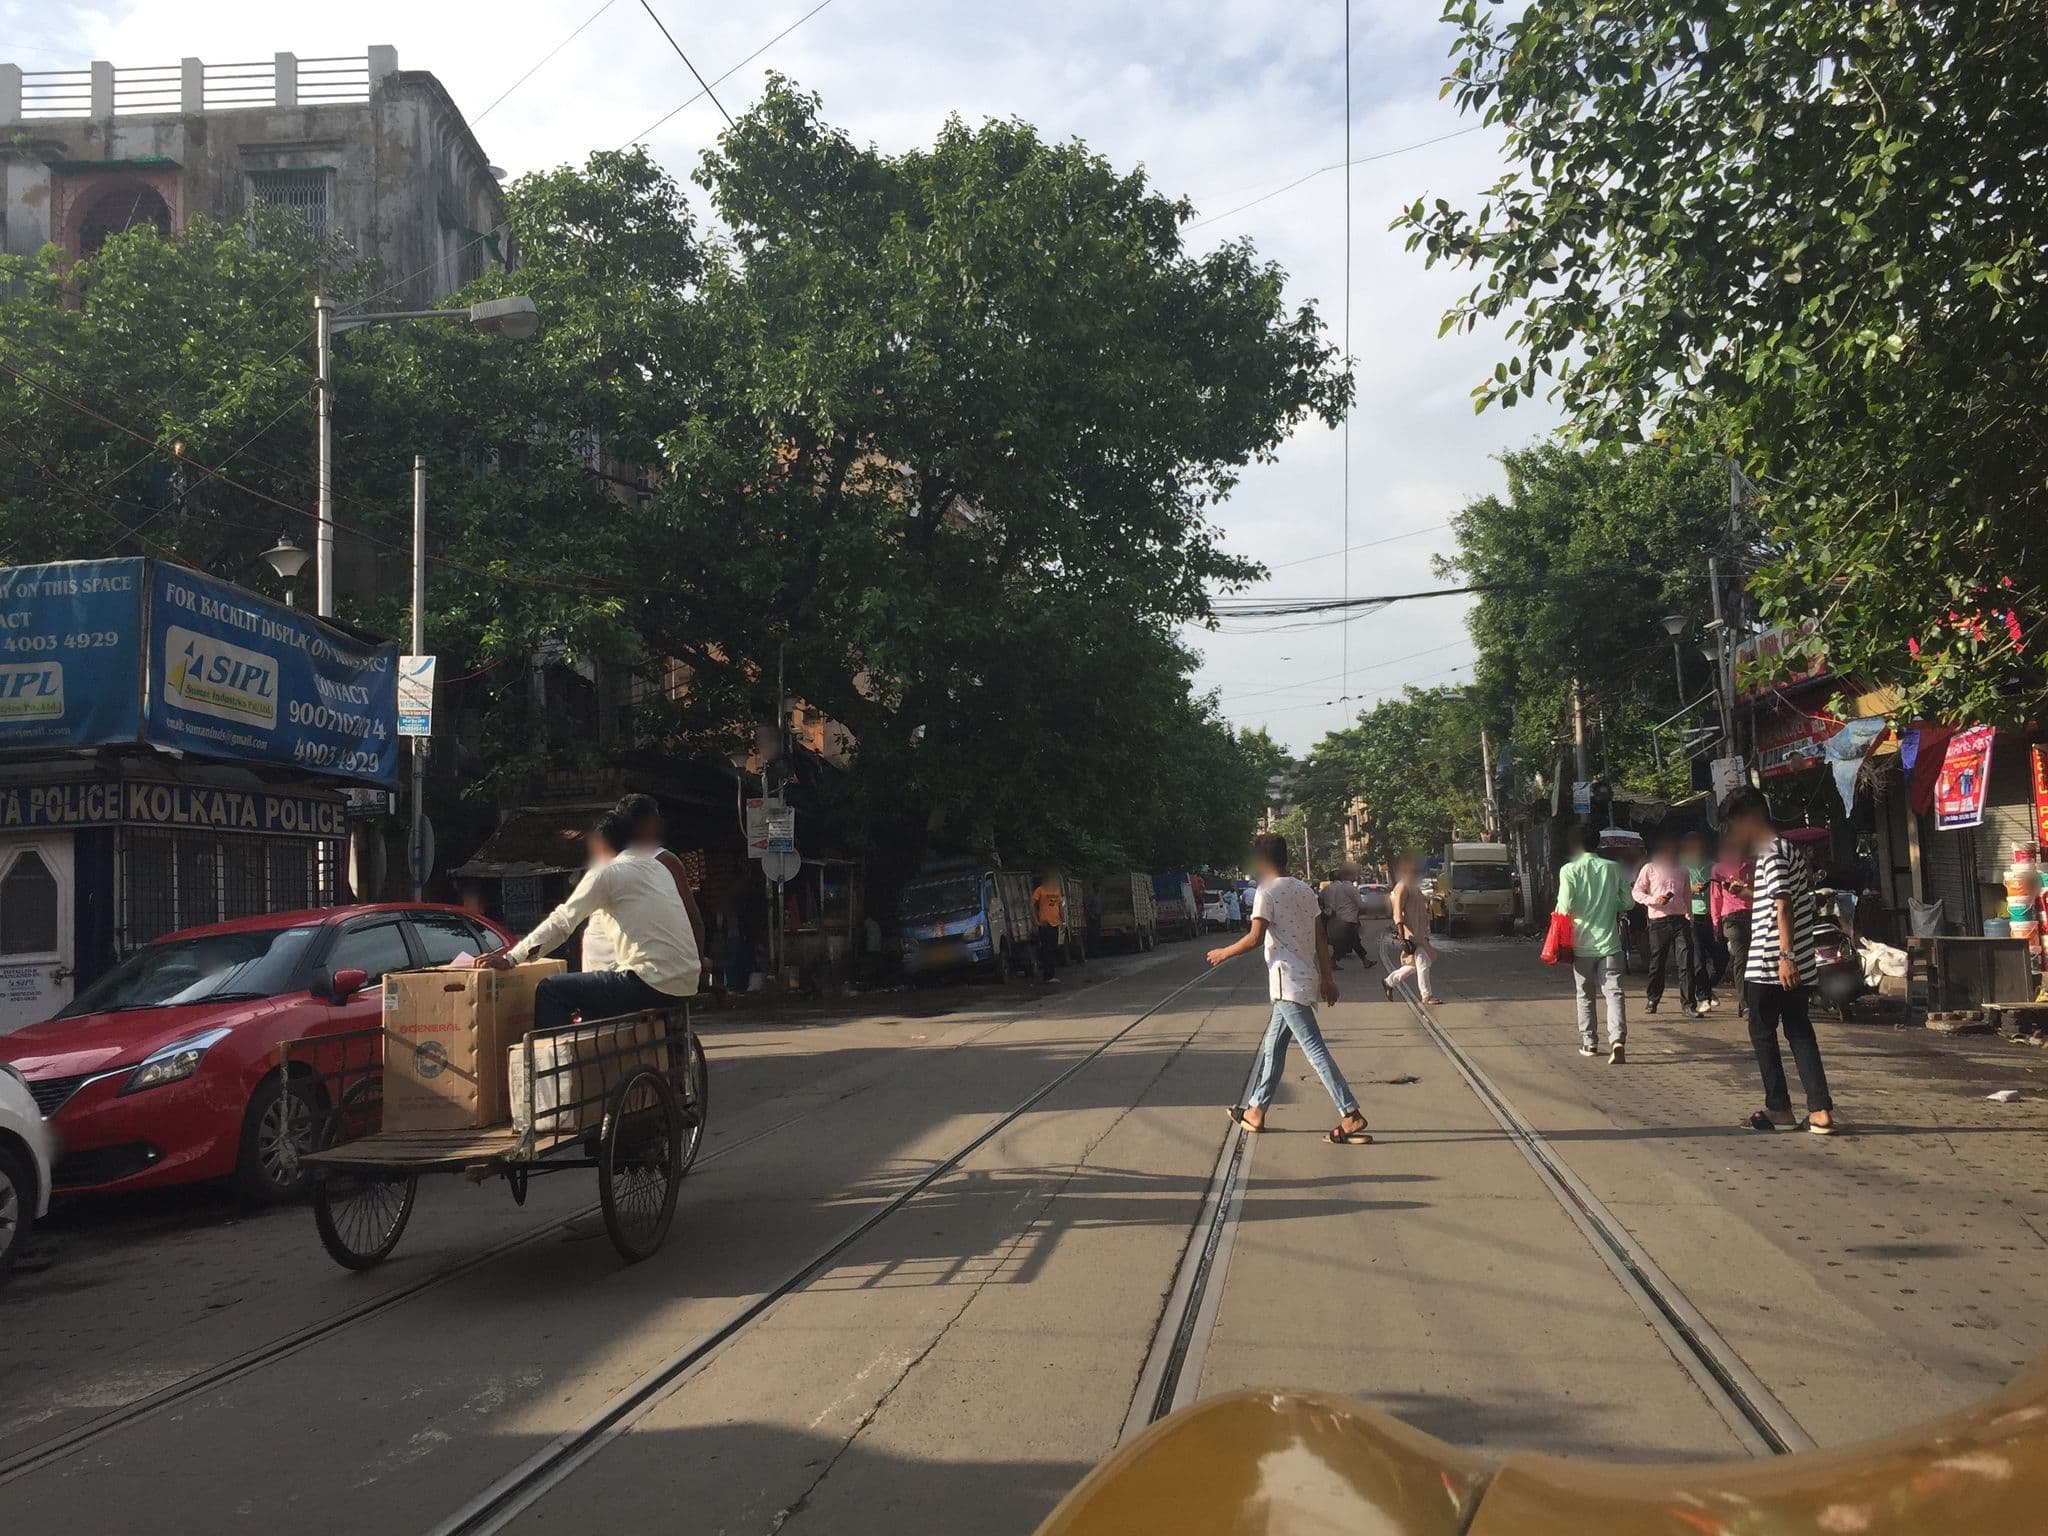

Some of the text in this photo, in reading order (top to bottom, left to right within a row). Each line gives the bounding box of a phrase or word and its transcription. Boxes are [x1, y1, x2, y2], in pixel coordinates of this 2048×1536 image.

[16, 581, 39, 598] ON
[42, 580, 78, 596] THIS
[82, 576, 132, 593] SPACE
[166, 582, 196, 611] FOR
[201, 596, 260, 632] BACKLIT
[262, 618, 310, 651] DISPLAY
[4, 632, 119, 652] 4003 4929
[207, 656, 274, 698] SIPL
[313, 673, 369, 705] CONTACT
[294, 737, 337, 766] 4003
[30, 784, 119, 824] POLICE
[129, 783, 346, 834] KOLKATA POLICE
[409, 1023, 463, 1033] GENERAL
